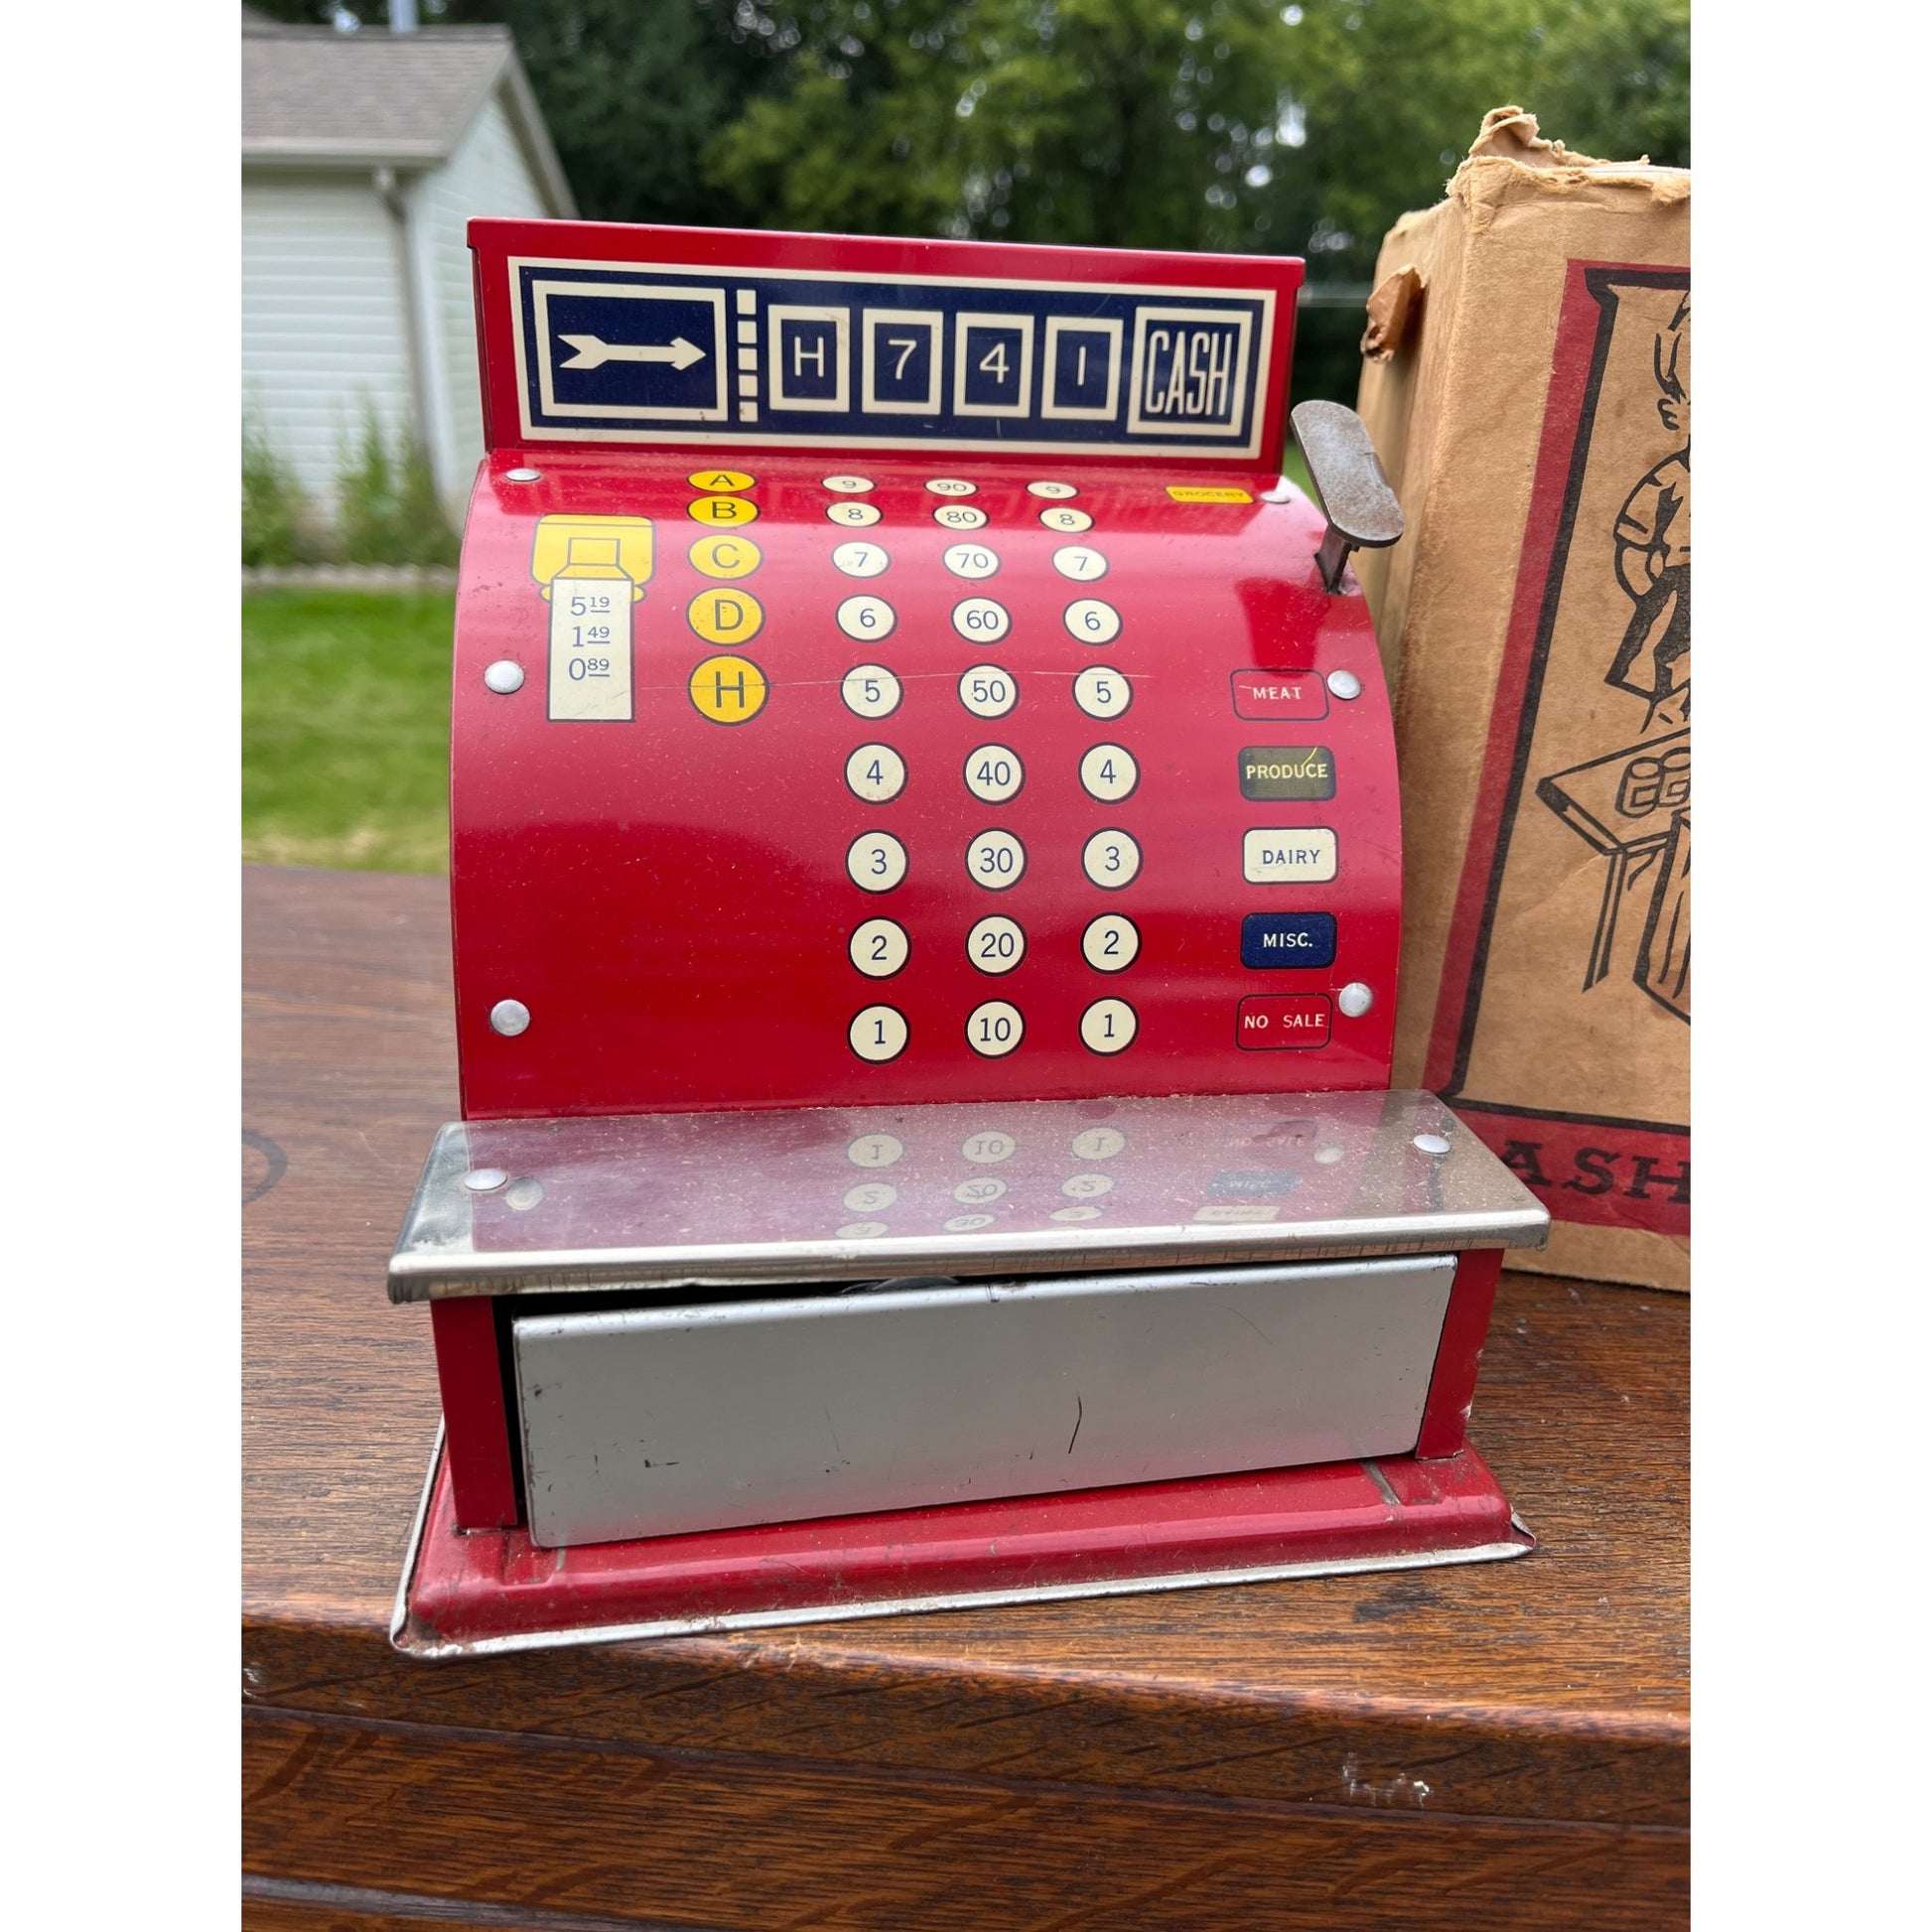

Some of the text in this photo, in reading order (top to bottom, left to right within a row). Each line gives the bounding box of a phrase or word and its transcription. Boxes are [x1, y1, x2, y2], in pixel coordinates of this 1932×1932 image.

[793, 336, 825, 378] H
[888, 338, 917, 380] 7
[978, 342, 1011, 384] 4
[1145, 329, 1234, 416] CASH
[709, 475, 736, 487] A
[842, 480, 857, 489] 9
[935, 483, 968, 492] 90
[1045, 485, 1060, 495] 9
[711, 500, 738, 519] B
[848, 508, 864, 521] 8
[946, 510, 978, 524] 80
[1059, 513, 1076, 526] 8
[712, 543, 741, 569] C
[854, 551, 870, 569] 7
[955, 552, 990, 570] 70
[1074, 555, 1089, 573] 7
[715, 599, 745, 630] D
[859, 607, 877, 628] 6
[965, 610, 1000, 630] 60
[1084, 611, 1101, 631] 6
[715, 670, 745, 708] H
[864, 679, 882, 704] 5
[972, 679, 1007, 704] 50
[1095, 680, 1112, 705] 5
[1252, 685, 1303, 701] MEAT
[866, 759, 885, 785] 4
[976, 760, 1011, 786] 40
[1099, 759, 1117, 784] 4
[1245, 762, 1328, 780] PRODUCE
[871, 848, 888, 875] 3
[979, 847, 1014, 874] 30
[1104, 845, 1121, 872] 3
[1261, 849, 1321, 866] DAIRY
[871, 934, 888, 961] 2
[980, 931, 1015, 958] 20
[1103, 929, 1120, 955] 2
[1263, 933, 1313, 948] MISC.
[874, 1019, 887, 1045] 1
[979, 1017, 1012, 1042] 10
[1103, 1013, 1115, 1038] 1
[1244, 1014, 1324, 1029] NO SALE
